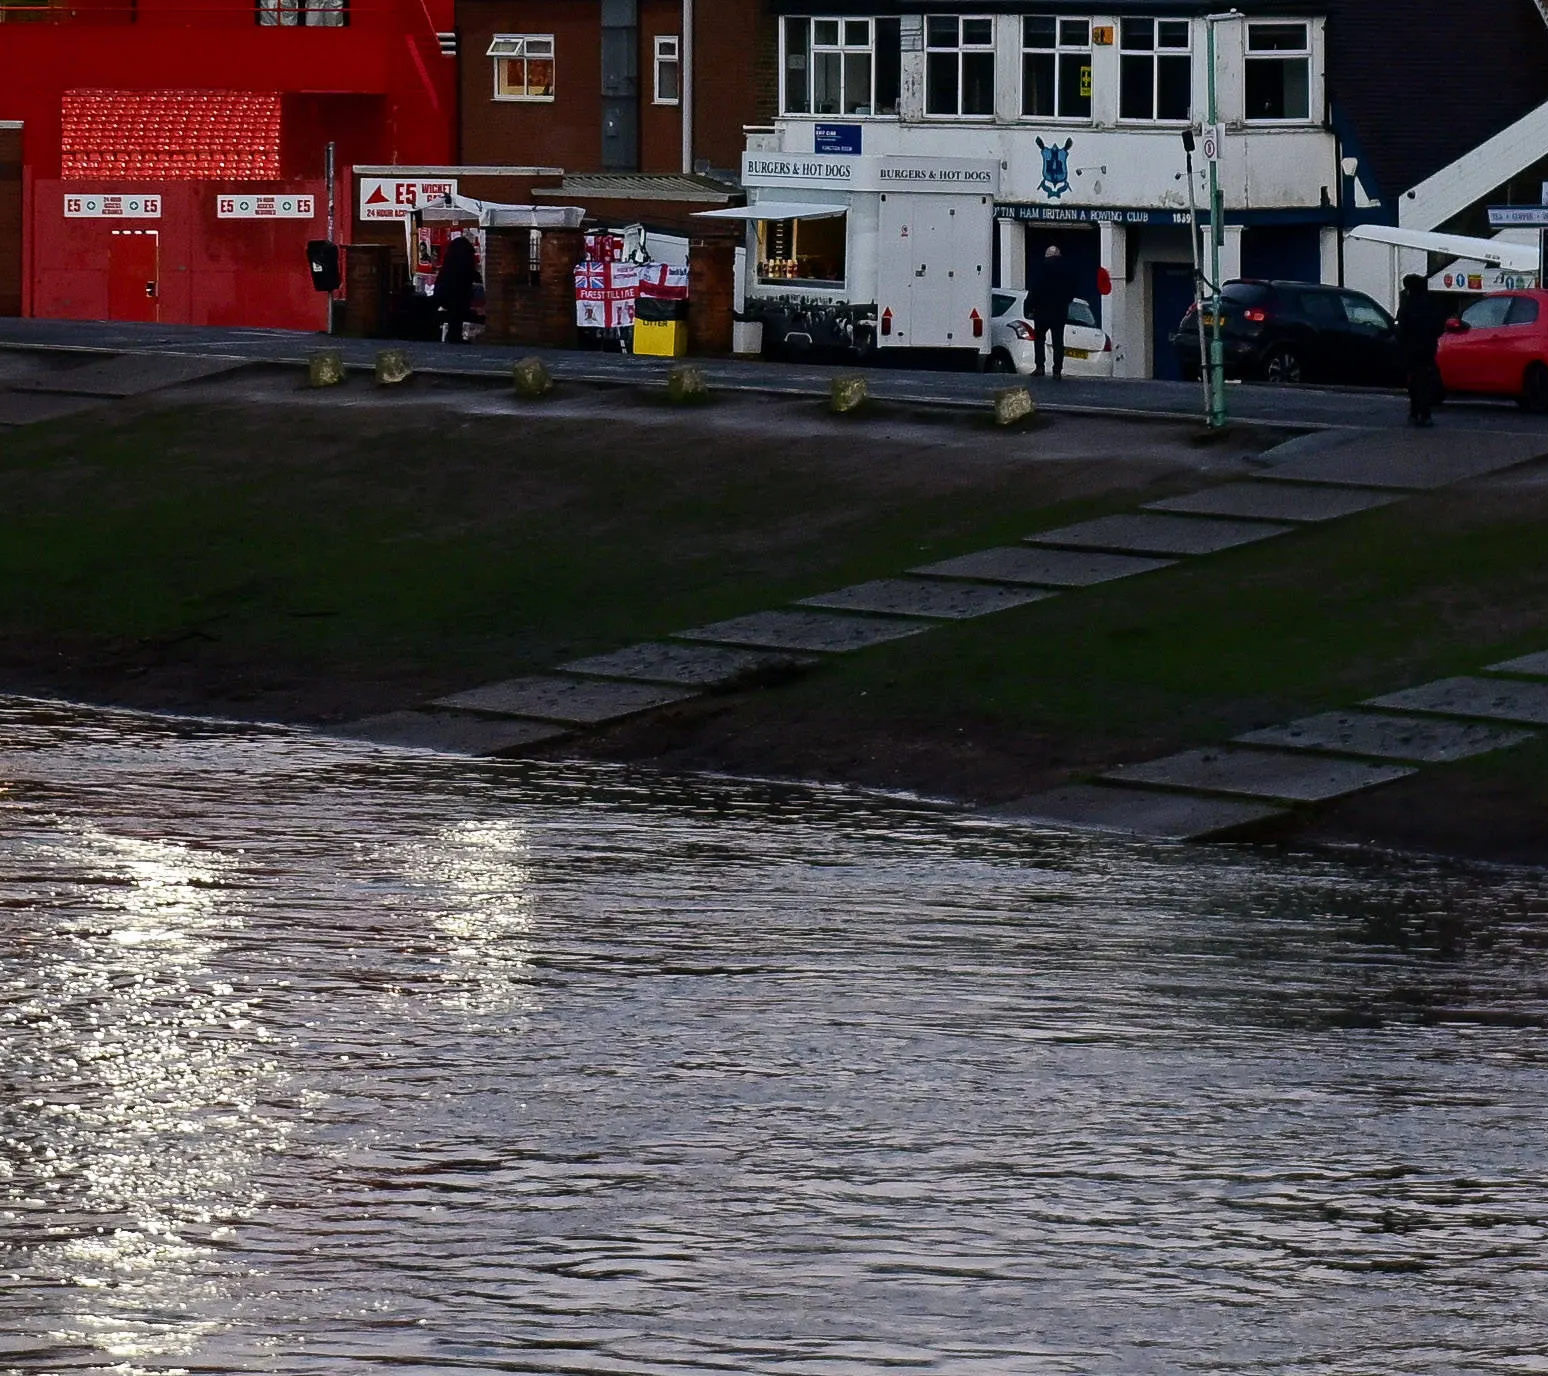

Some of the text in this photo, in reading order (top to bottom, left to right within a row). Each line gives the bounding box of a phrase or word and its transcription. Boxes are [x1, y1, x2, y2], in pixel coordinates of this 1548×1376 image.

[748, 160, 851, 178] BURGERS & HOT DOGS
[880, 169, 991, 181] BURGERS & HOT DOGS
[395, 183, 416, 204] E5
[422, 183, 452, 193] WICKET
[67, 199, 157, 213] E5 E5
[220, 199, 311, 213] E5 E5
[366, 209, 375, 217] 24
[376, 209, 393, 217] HOUR
[1090, 210, 1122, 222] ROWING
[1126, 211, 1149, 222] CLUB
[1172, 213, 1191, 223] 1839
[580, 289, 605, 299] FOREST
